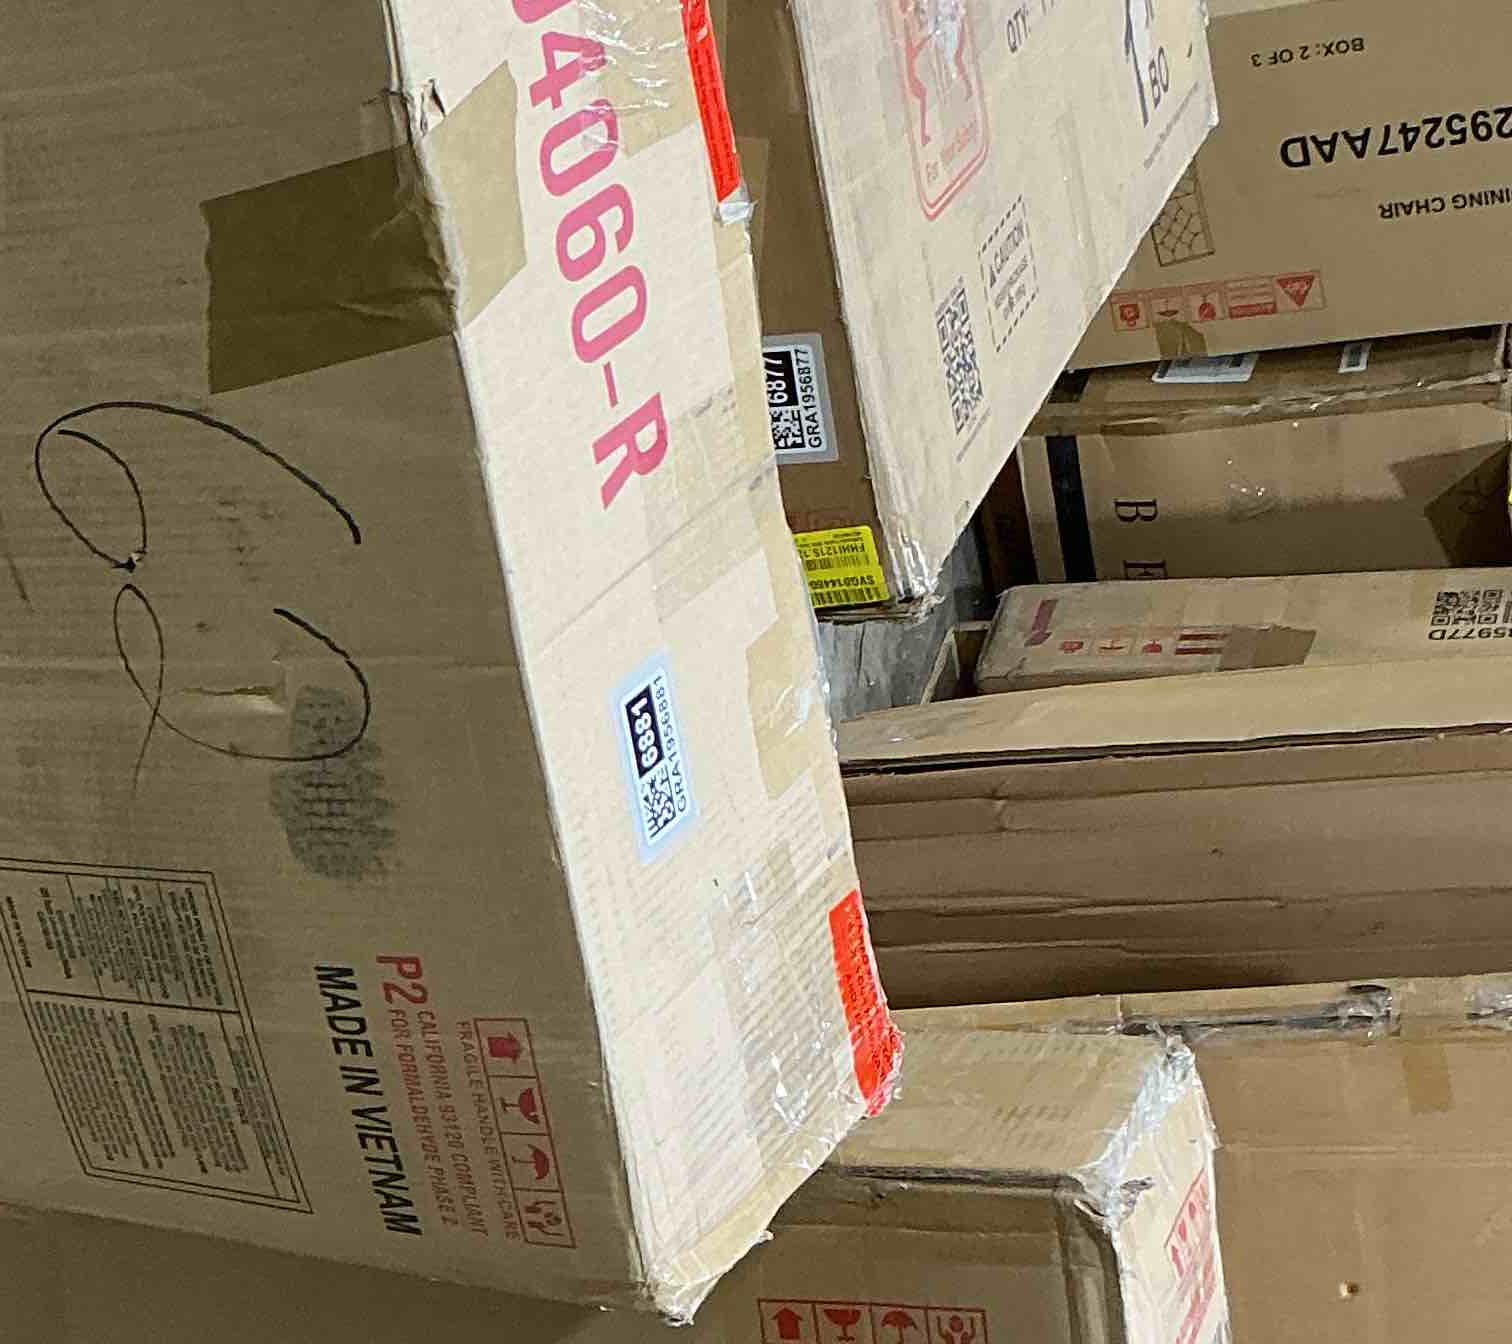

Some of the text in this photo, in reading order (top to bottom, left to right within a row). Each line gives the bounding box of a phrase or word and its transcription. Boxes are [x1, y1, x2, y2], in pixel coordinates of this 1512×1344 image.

[1250, 37, 1365, 68] BOX: 2 OF 3
[1378, 195, 1447, 220] CHAIR
[794, 347, 823, 449] GRA1956877
[630, 696, 659, 768] 6881
[652, 674, 687, 812] GRA1956881
[375, 954, 429, 1004] P2
[416, 1010, 453, 1101] CALIFORNIA
[314, 965, 423, 1237] MADE IN VIETNAM
